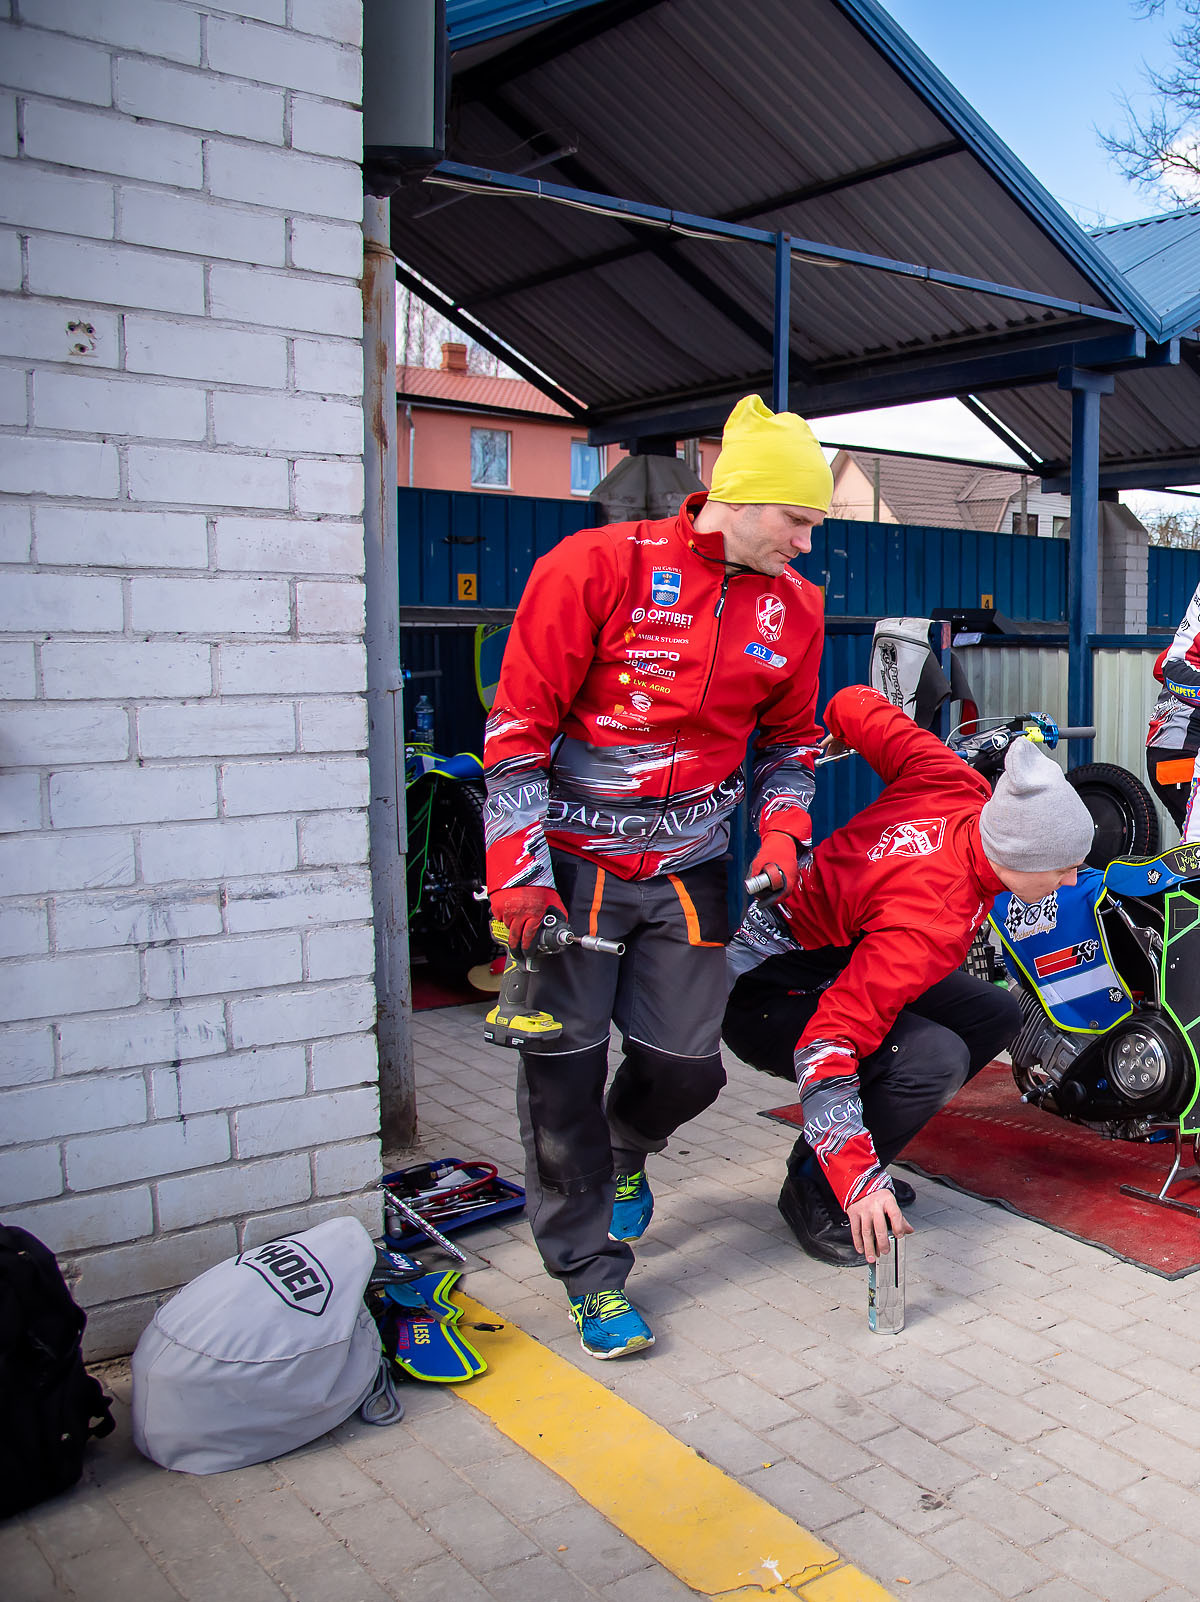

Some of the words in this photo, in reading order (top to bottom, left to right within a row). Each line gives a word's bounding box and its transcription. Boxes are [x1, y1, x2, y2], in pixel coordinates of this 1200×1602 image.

[463, 579, 473, 596] 2
[648, 609, 694, 626] OPTIBET
[637, 633, 659, 643] AMBER
[661, 636, 690, 645] STUDIOS
[626, 649, 680, 662] TRODO
[633, 679, 647, 687] LVK
[649, 683, 671, 694] AGRO
[1168, 682, 1196, 698] CARPETS
[412, 1324, 431, 1345] LESS
